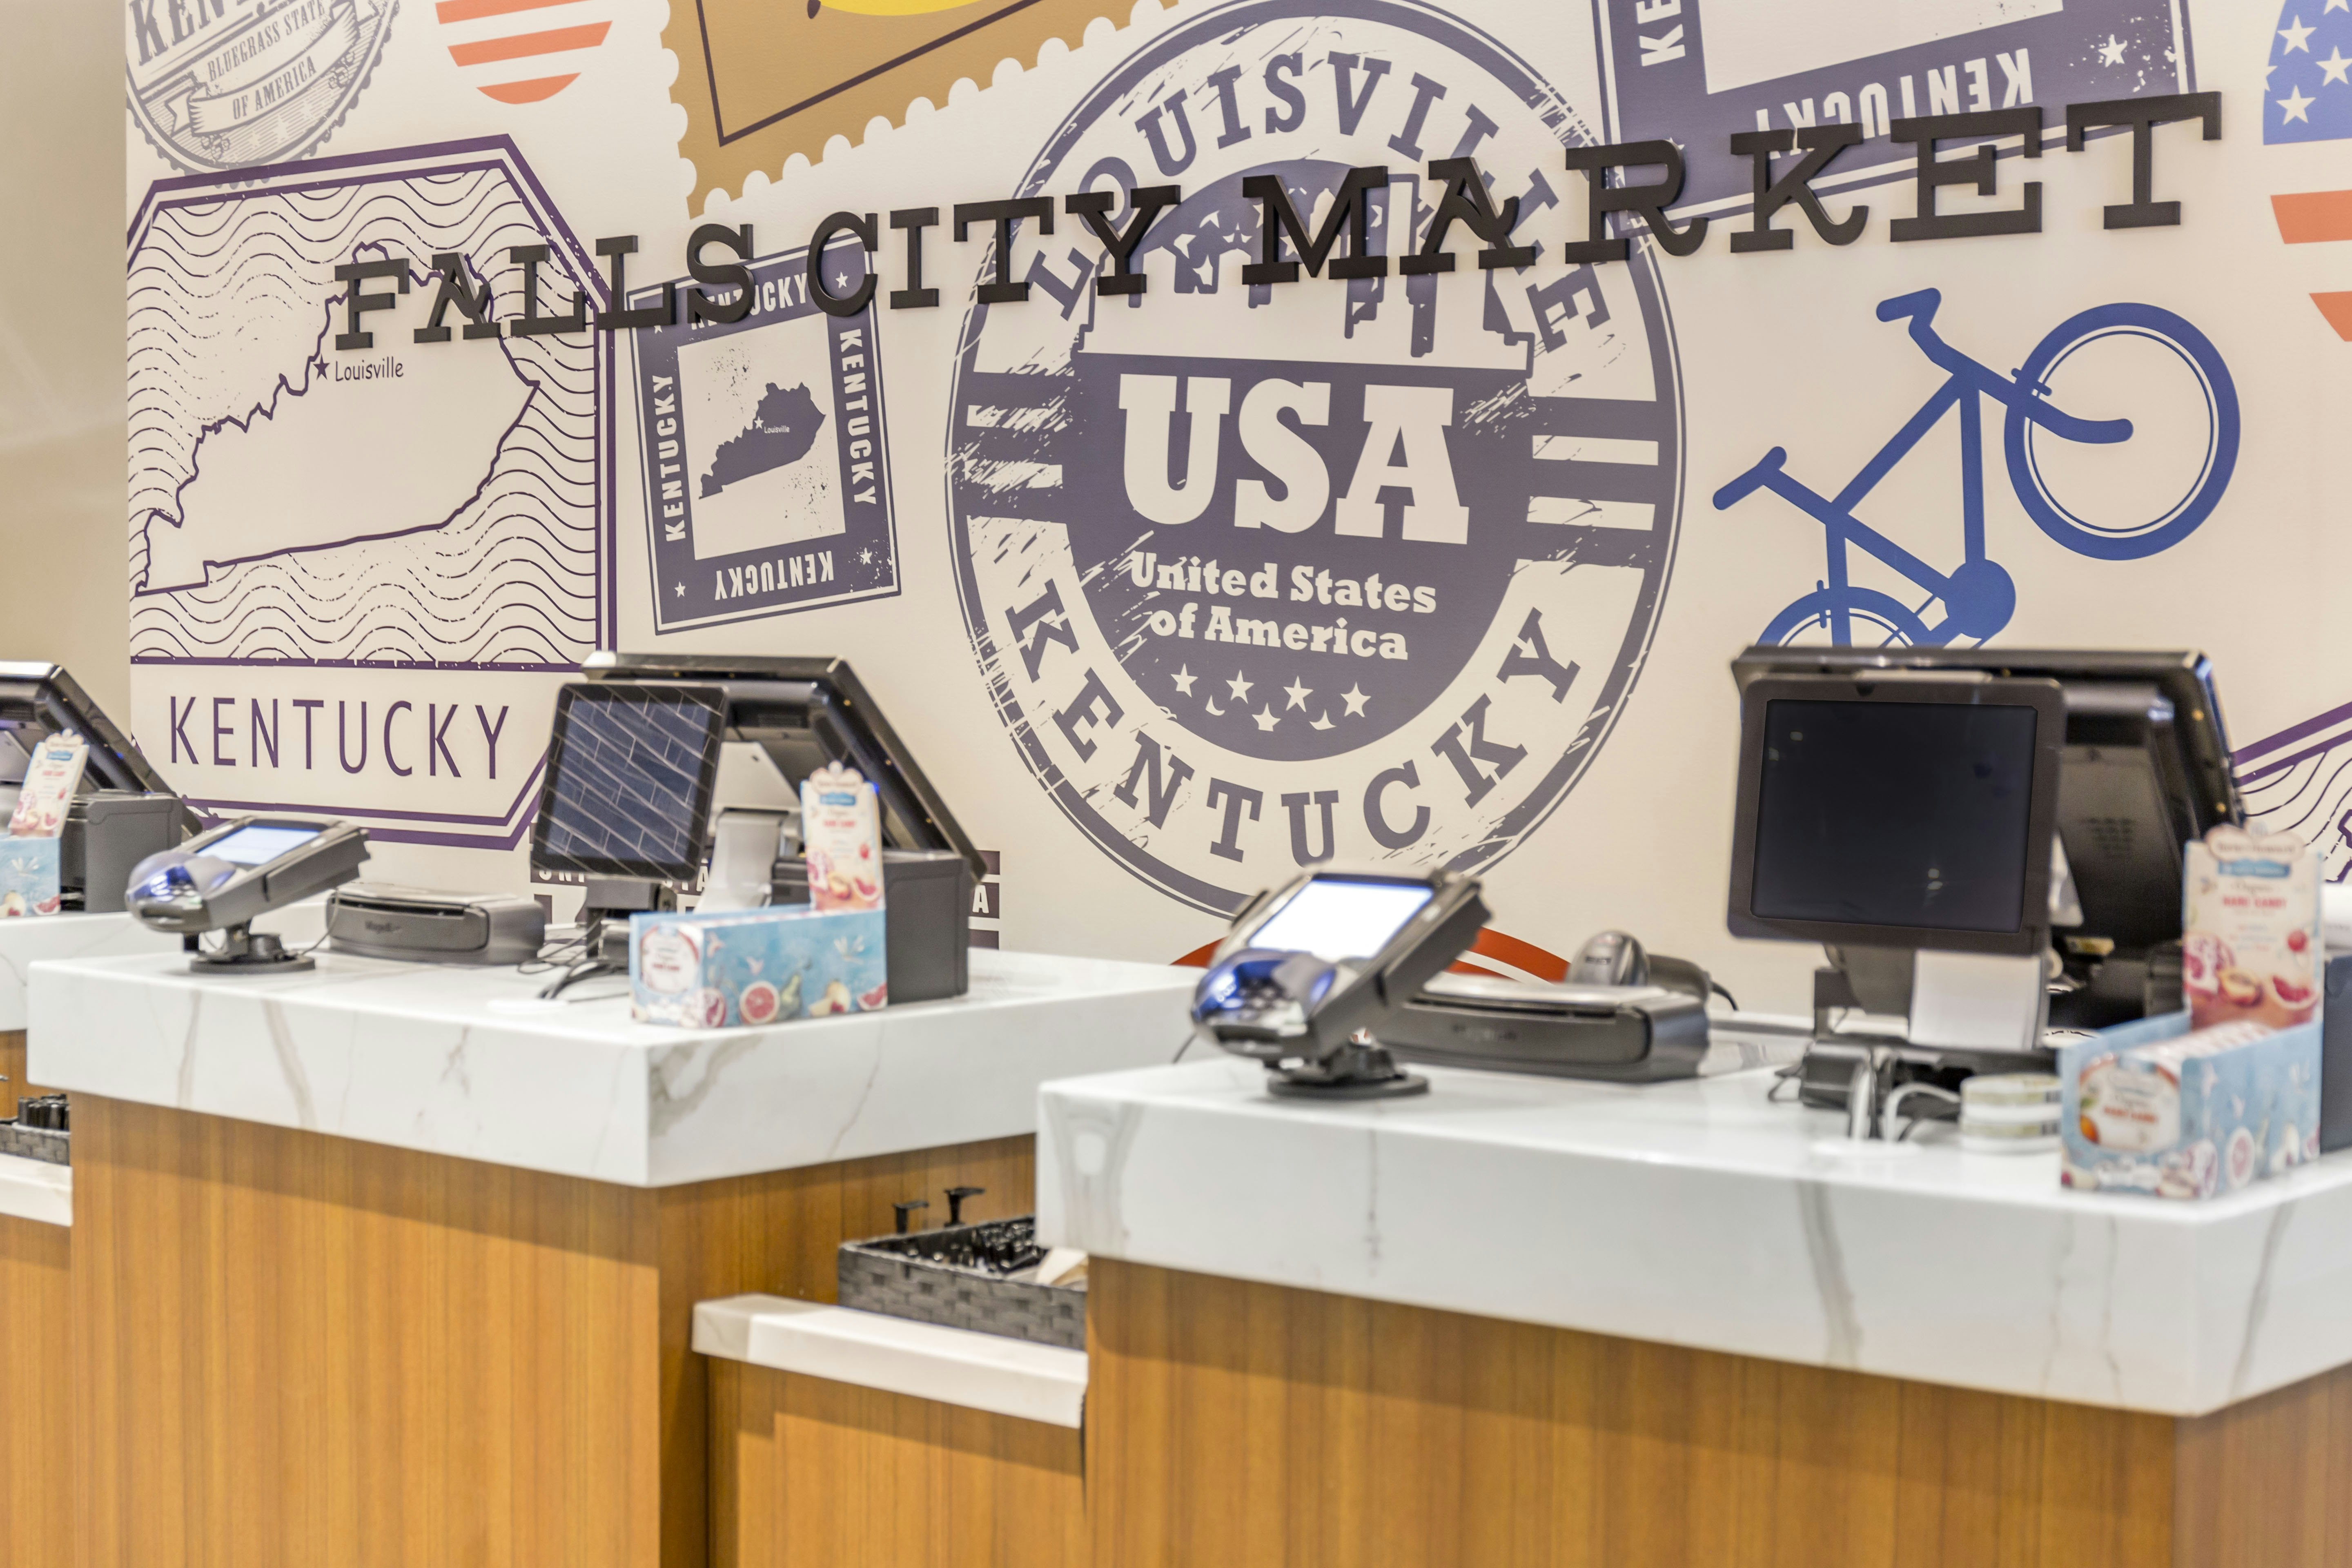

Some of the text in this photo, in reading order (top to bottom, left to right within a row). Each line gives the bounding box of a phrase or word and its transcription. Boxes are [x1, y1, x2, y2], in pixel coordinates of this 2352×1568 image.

[206, 20, 281, 82] BLUEGRASS
[285, 0, 326, 36] STATE
[232, 54, 317, 120] OF AMERICA
[334, 91, 2222, 350] FALLS CITY MARKET
[690, 272, 808, 330] UCKY
[335, 356, 404, 382] Louisville
[764, 425, 790, 434] Louisville
[839, 328, 877, 505] KENTUCKY
[652, 375, 687, 542] KENTUCKY
[1118, 373, 1470, 545] USA
[714, 550, 835, 601] KENTUCKY
[1130, 550, 1437, 614] United States
[1149, 602, 1408, 661] of America
[169, 696, 509, 780] KENTUCKY
[1004, 578, 1581, 867] KENTUCKY
